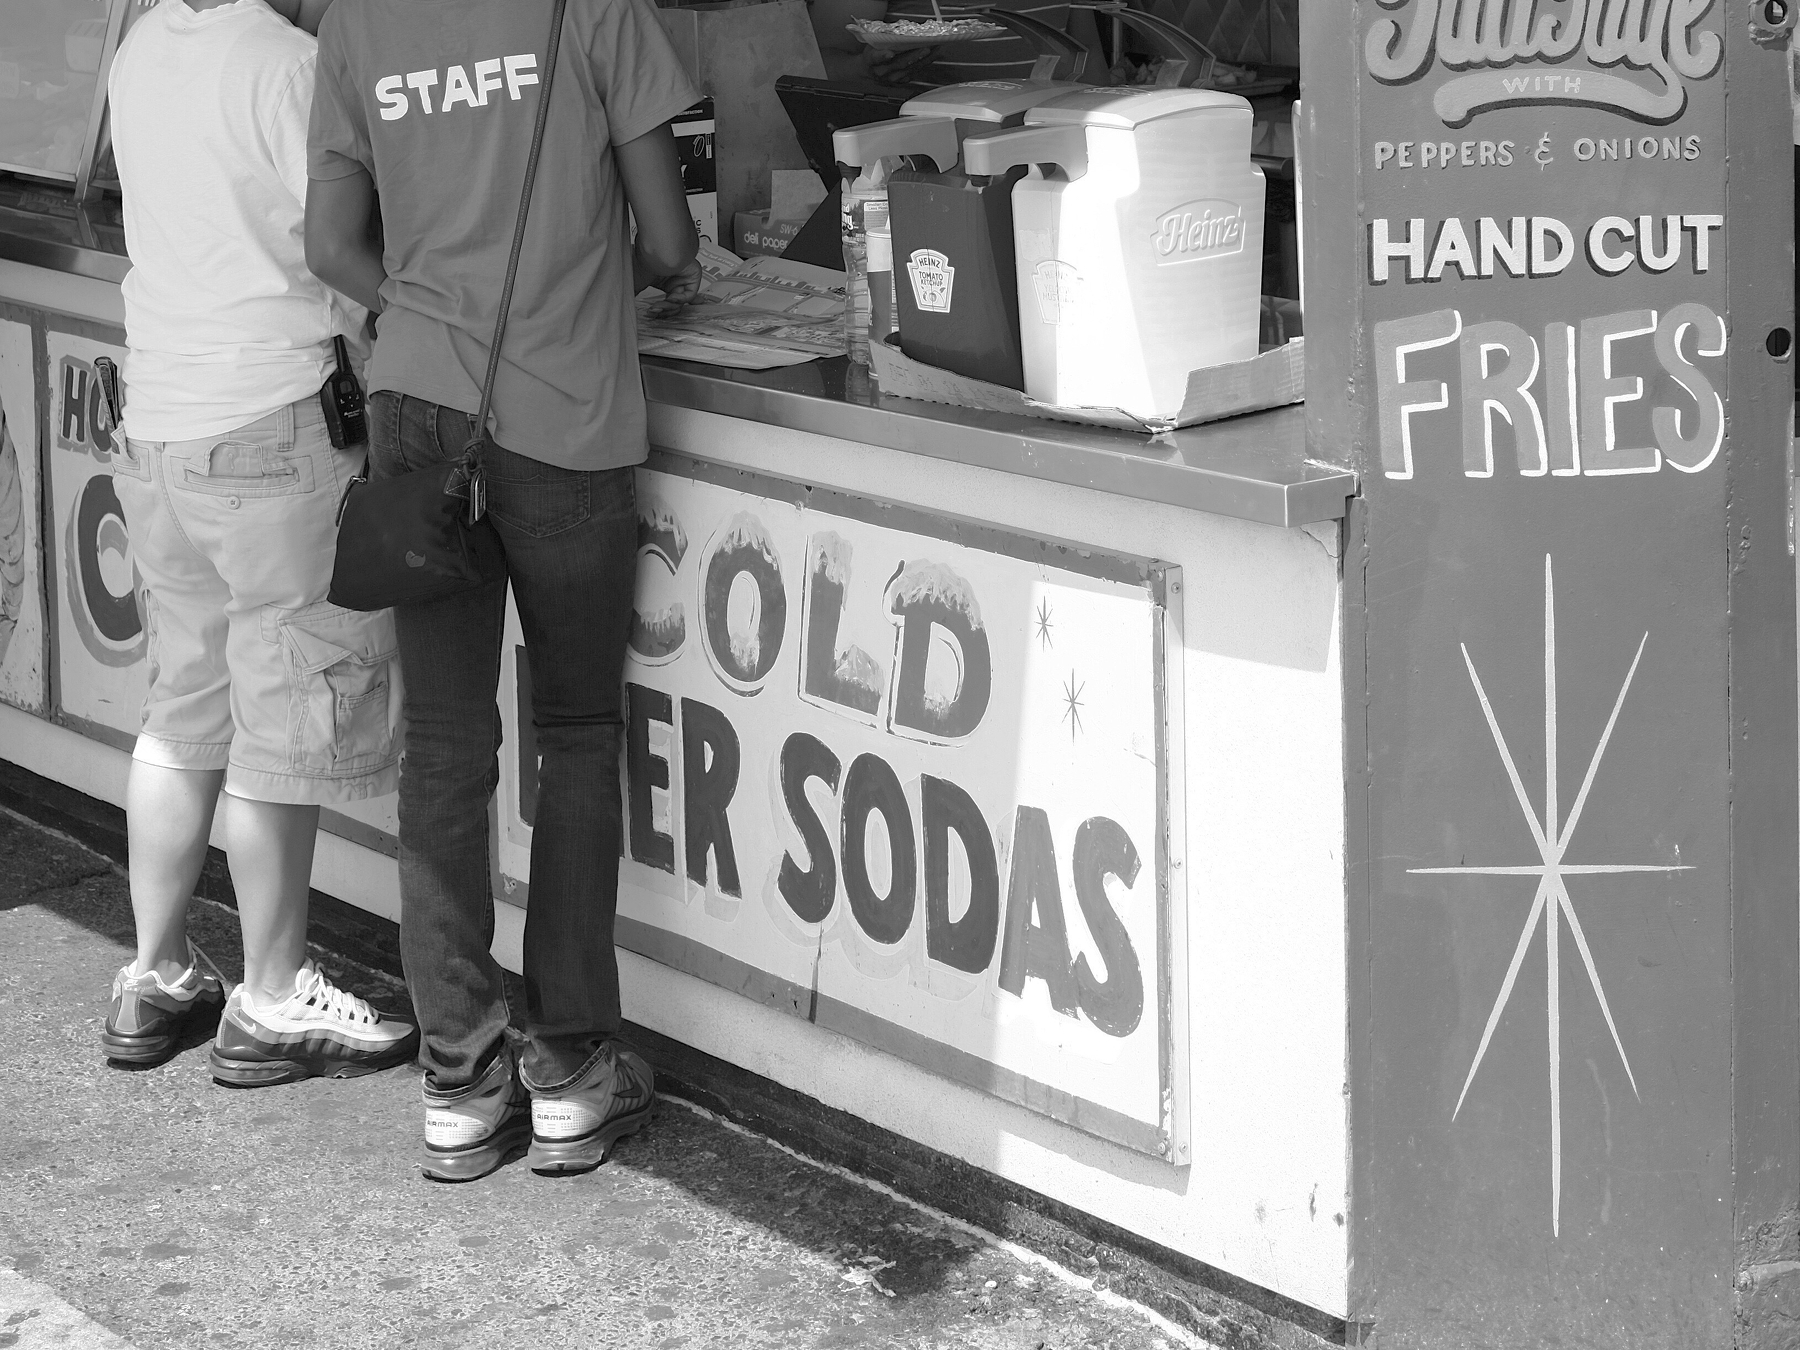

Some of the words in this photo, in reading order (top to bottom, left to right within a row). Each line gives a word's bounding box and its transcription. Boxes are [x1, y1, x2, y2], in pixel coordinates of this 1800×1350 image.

[375, 54, 539, 120] STAFF
[1503, 75, 1581, 94] WITH
[1374, 140, 1515, 170] PEPPERS
[1574, 135, 1702, 162] ONIONS
[1156, 209, 1239, 256] Heinz
[1367, 216, 1575, 285] HAND
[1585, 214, 1723, 277] CUT
[918, 257, 941, 268] HEINZ
[919, 271, 943, 281] TOMATO
[1373, 303, 1727, 480] FRIES
[775, 731, 1145, 1038] SODAS
